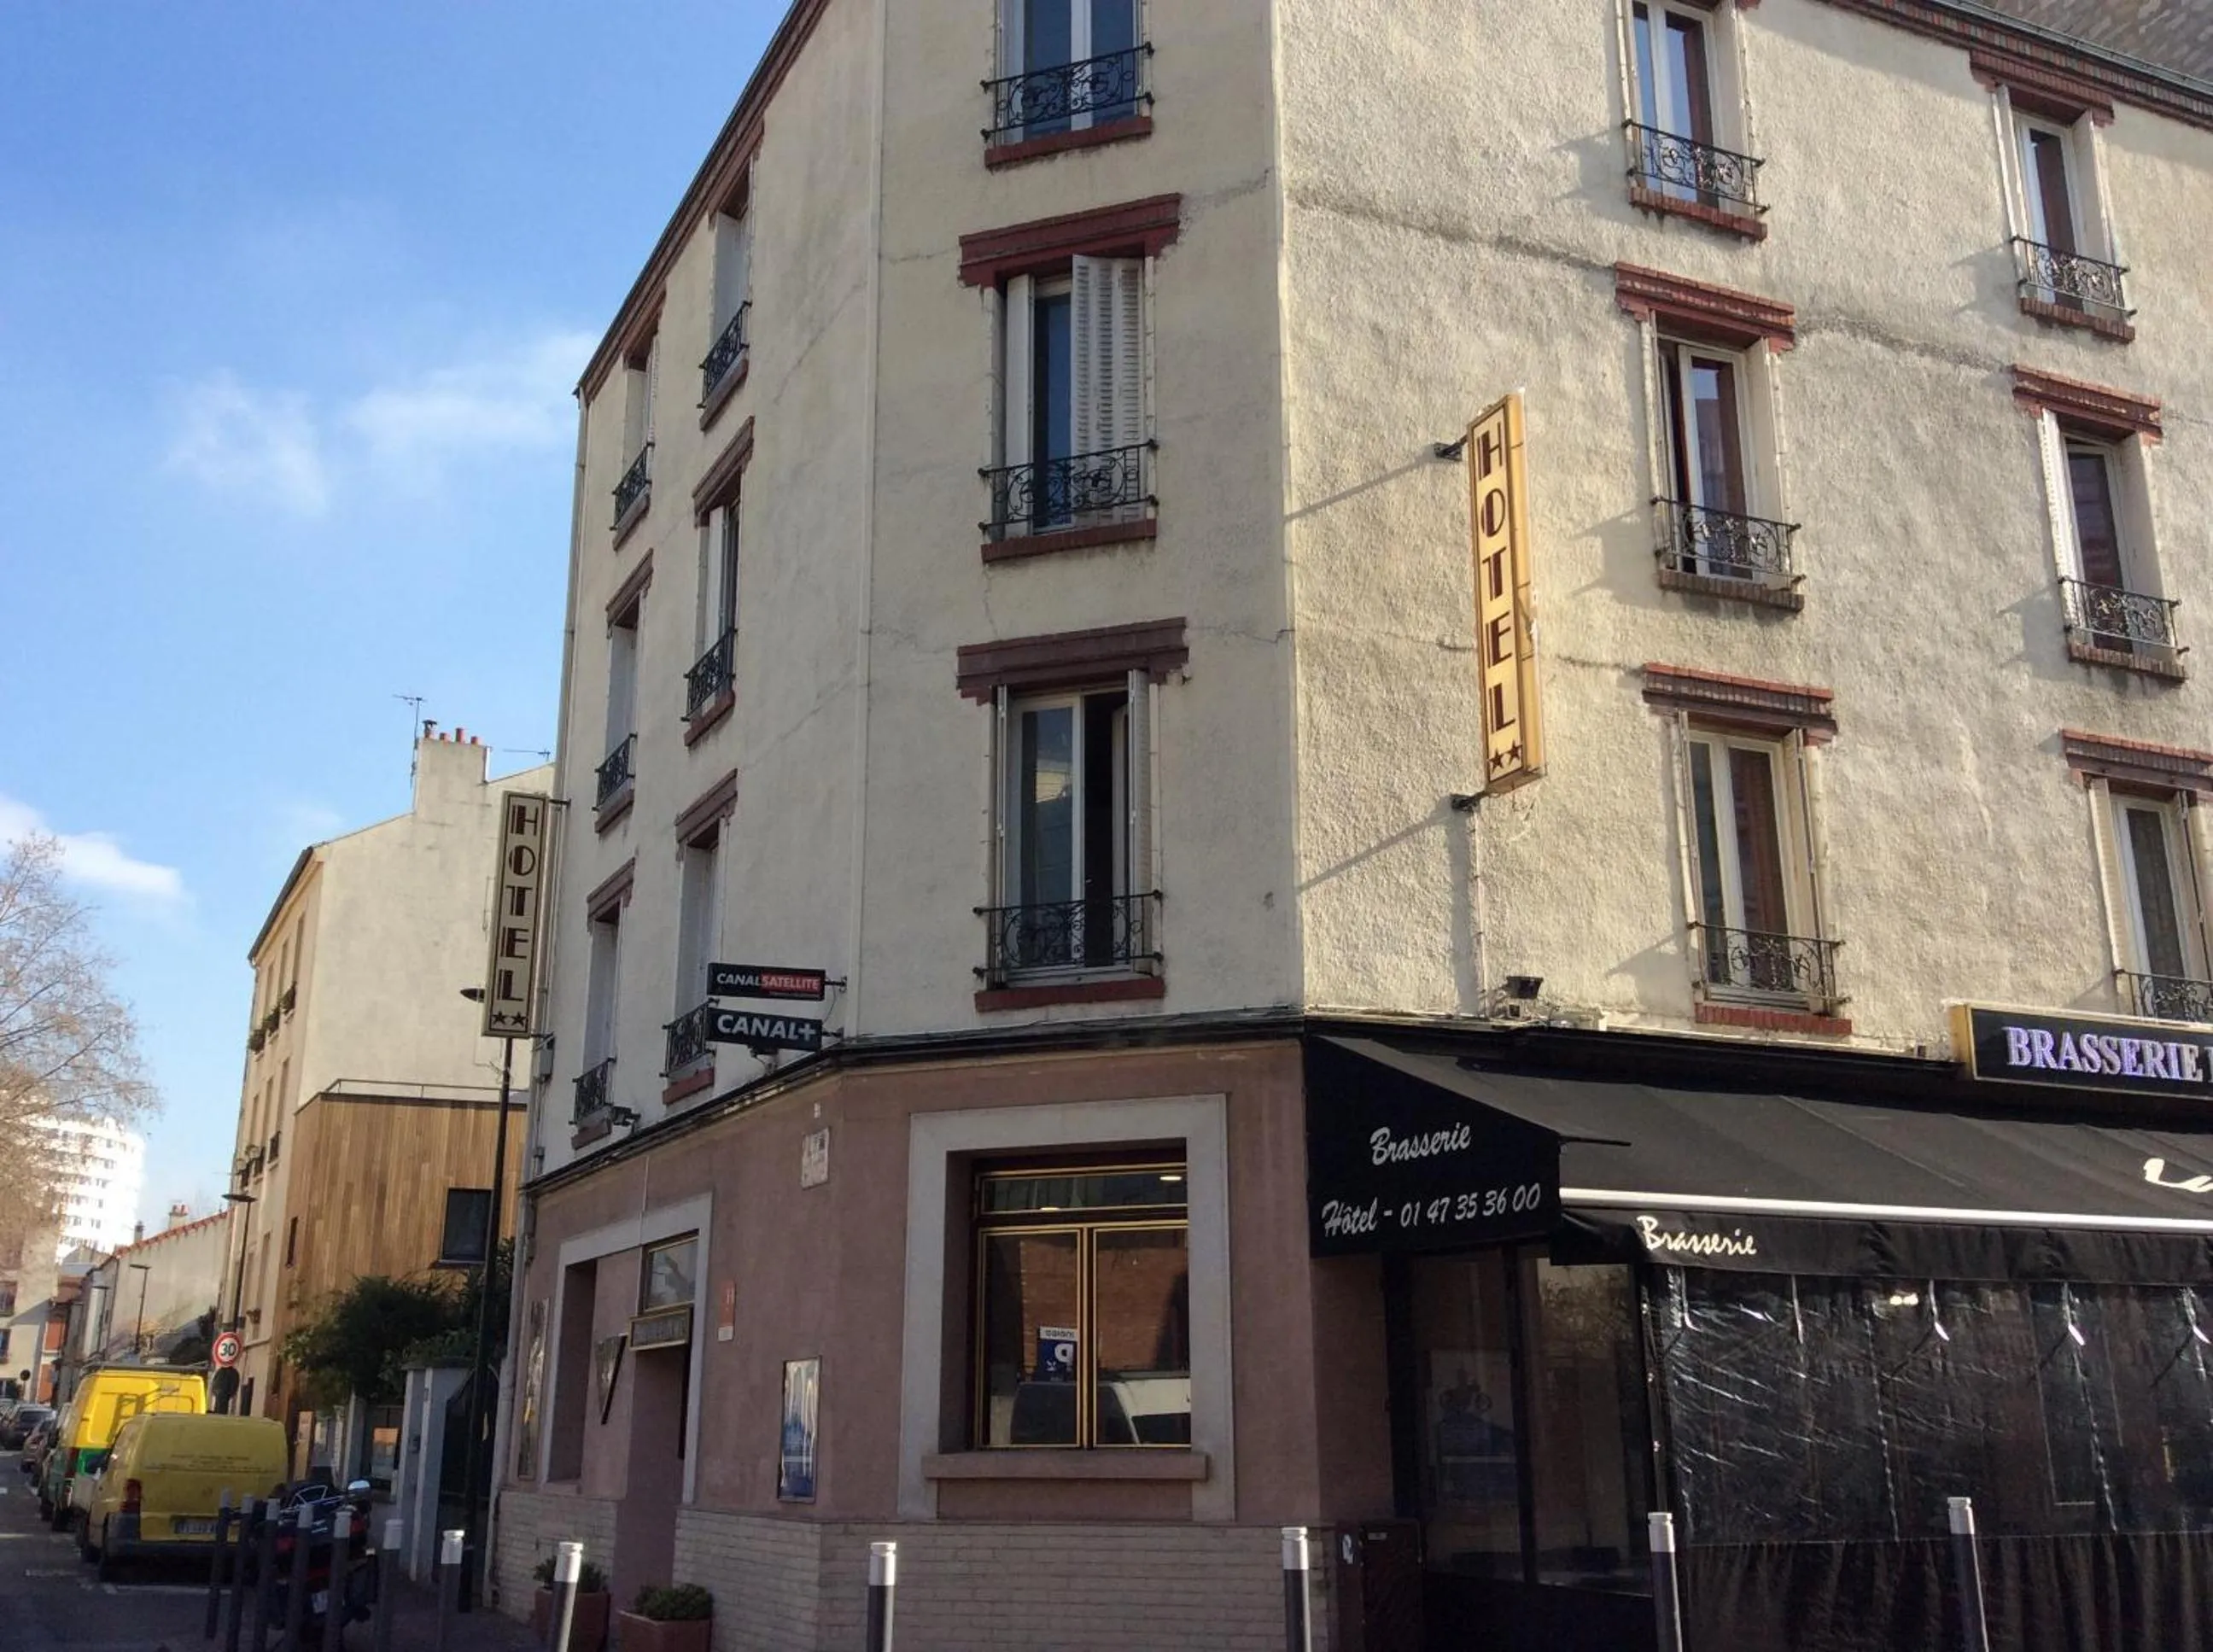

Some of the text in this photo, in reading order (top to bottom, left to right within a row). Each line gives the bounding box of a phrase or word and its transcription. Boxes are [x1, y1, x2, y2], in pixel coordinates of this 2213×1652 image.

[1476, 421, 1515, 734] HOTEL
[497, 804, 539, 1002] HOTEL
[717, 1014, 816, 1042] CANAL+
[2002, 1026, 2204, 1083] BRASSERIE
[1369, 1122, 1471, 1165] Brasserie
[1322, 1197, 1378, 1237] Hôtel
[1400, 1201, 1421, 1228] 01
[1427, 1197, 1451, 1224] 47
[1455, 1192, 1478, 1221] 35
[1483, 1188, 1509, 1216] 36
[1513, 1182, 1541, 1211] 00
[1637, 1215, 1756, 1255] Brasserie
[220, 1342, 237, 1357] 30
